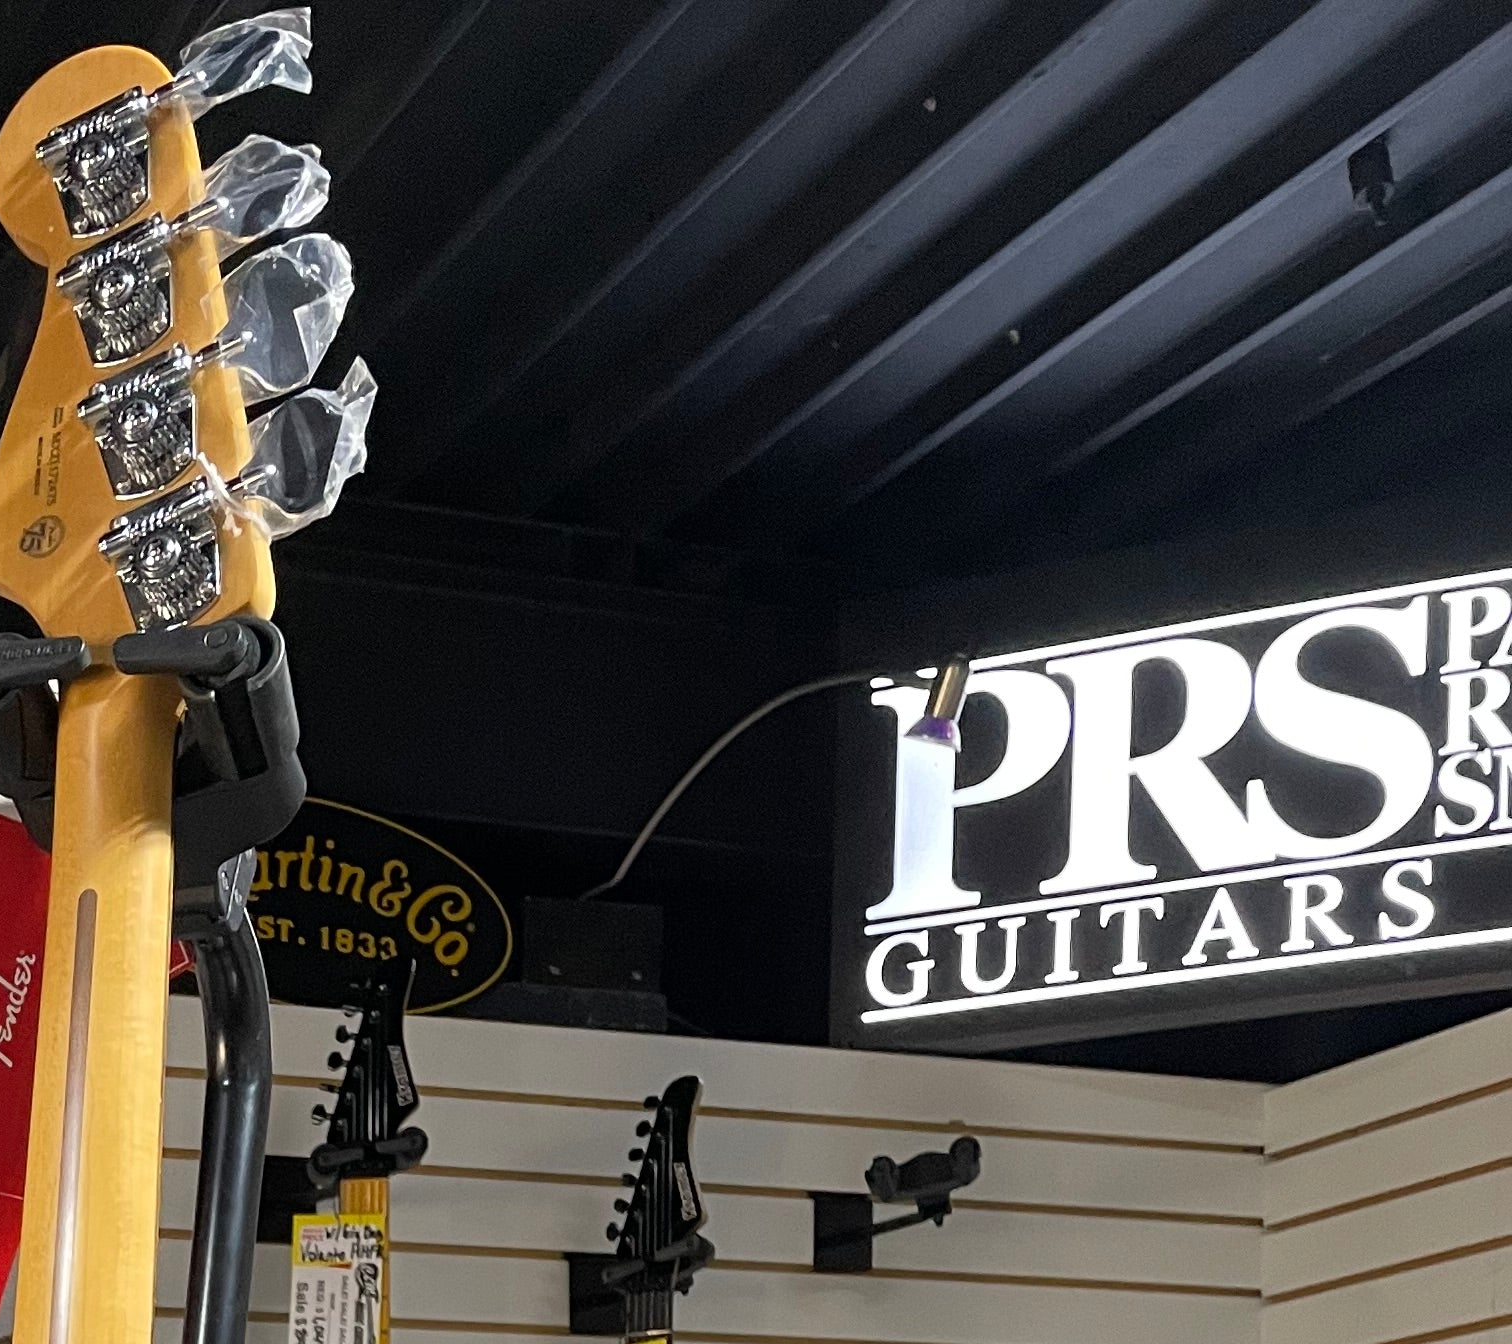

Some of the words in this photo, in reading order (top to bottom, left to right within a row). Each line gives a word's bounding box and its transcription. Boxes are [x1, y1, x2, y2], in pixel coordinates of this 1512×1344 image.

[865, 596, 1434, 921] PRS
[320, 926, 398, 960] 1833
[865, 859, 1436, 1007] GUITARS
